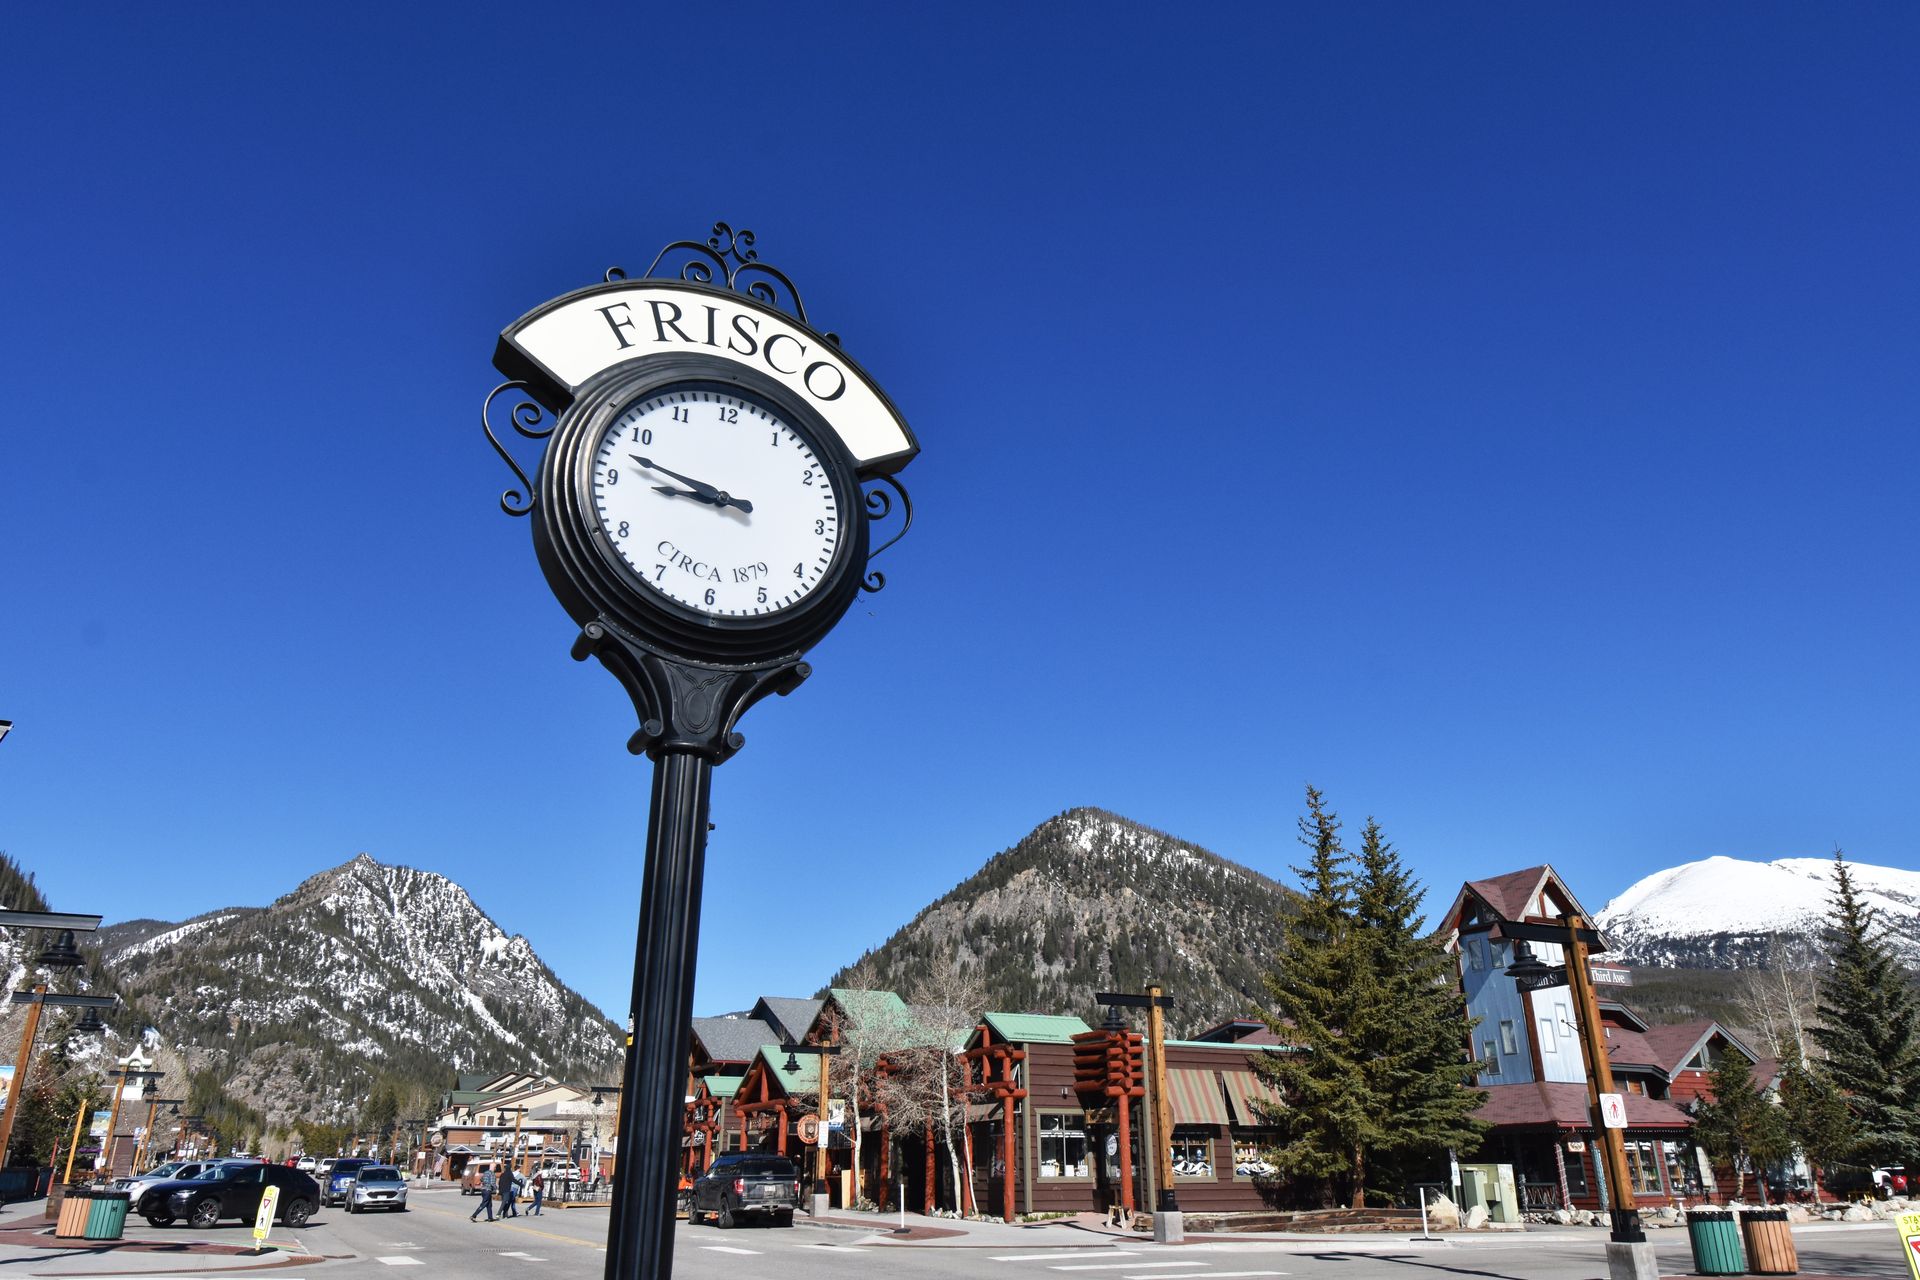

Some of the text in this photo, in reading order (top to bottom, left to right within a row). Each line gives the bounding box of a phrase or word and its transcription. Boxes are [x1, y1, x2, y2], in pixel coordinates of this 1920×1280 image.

[594, 299, 847, 401] FRISCO
[672, 406, 689, 424] 11
[719, 407, 738, 425] 12
[631, 427, 652, 446] 10
[771, 432, 779, 447] 1
[607, 469, 618, 486] 9
[803, 470, 813, 486] 2
[618, 521, 629, 538] 8
[815, 519, 825, 536] 3
[657, 540, 769, 583] CIRCA 1879
[655, 563, 667, 581] 7
[793, 562, 804, 579] 4
[704, 588, 715, 606] 6
[757, 587, 768, 604] 5
[1549, 973, 1559, 985] St
[1591, 970, 1626, 984] Third Ave
